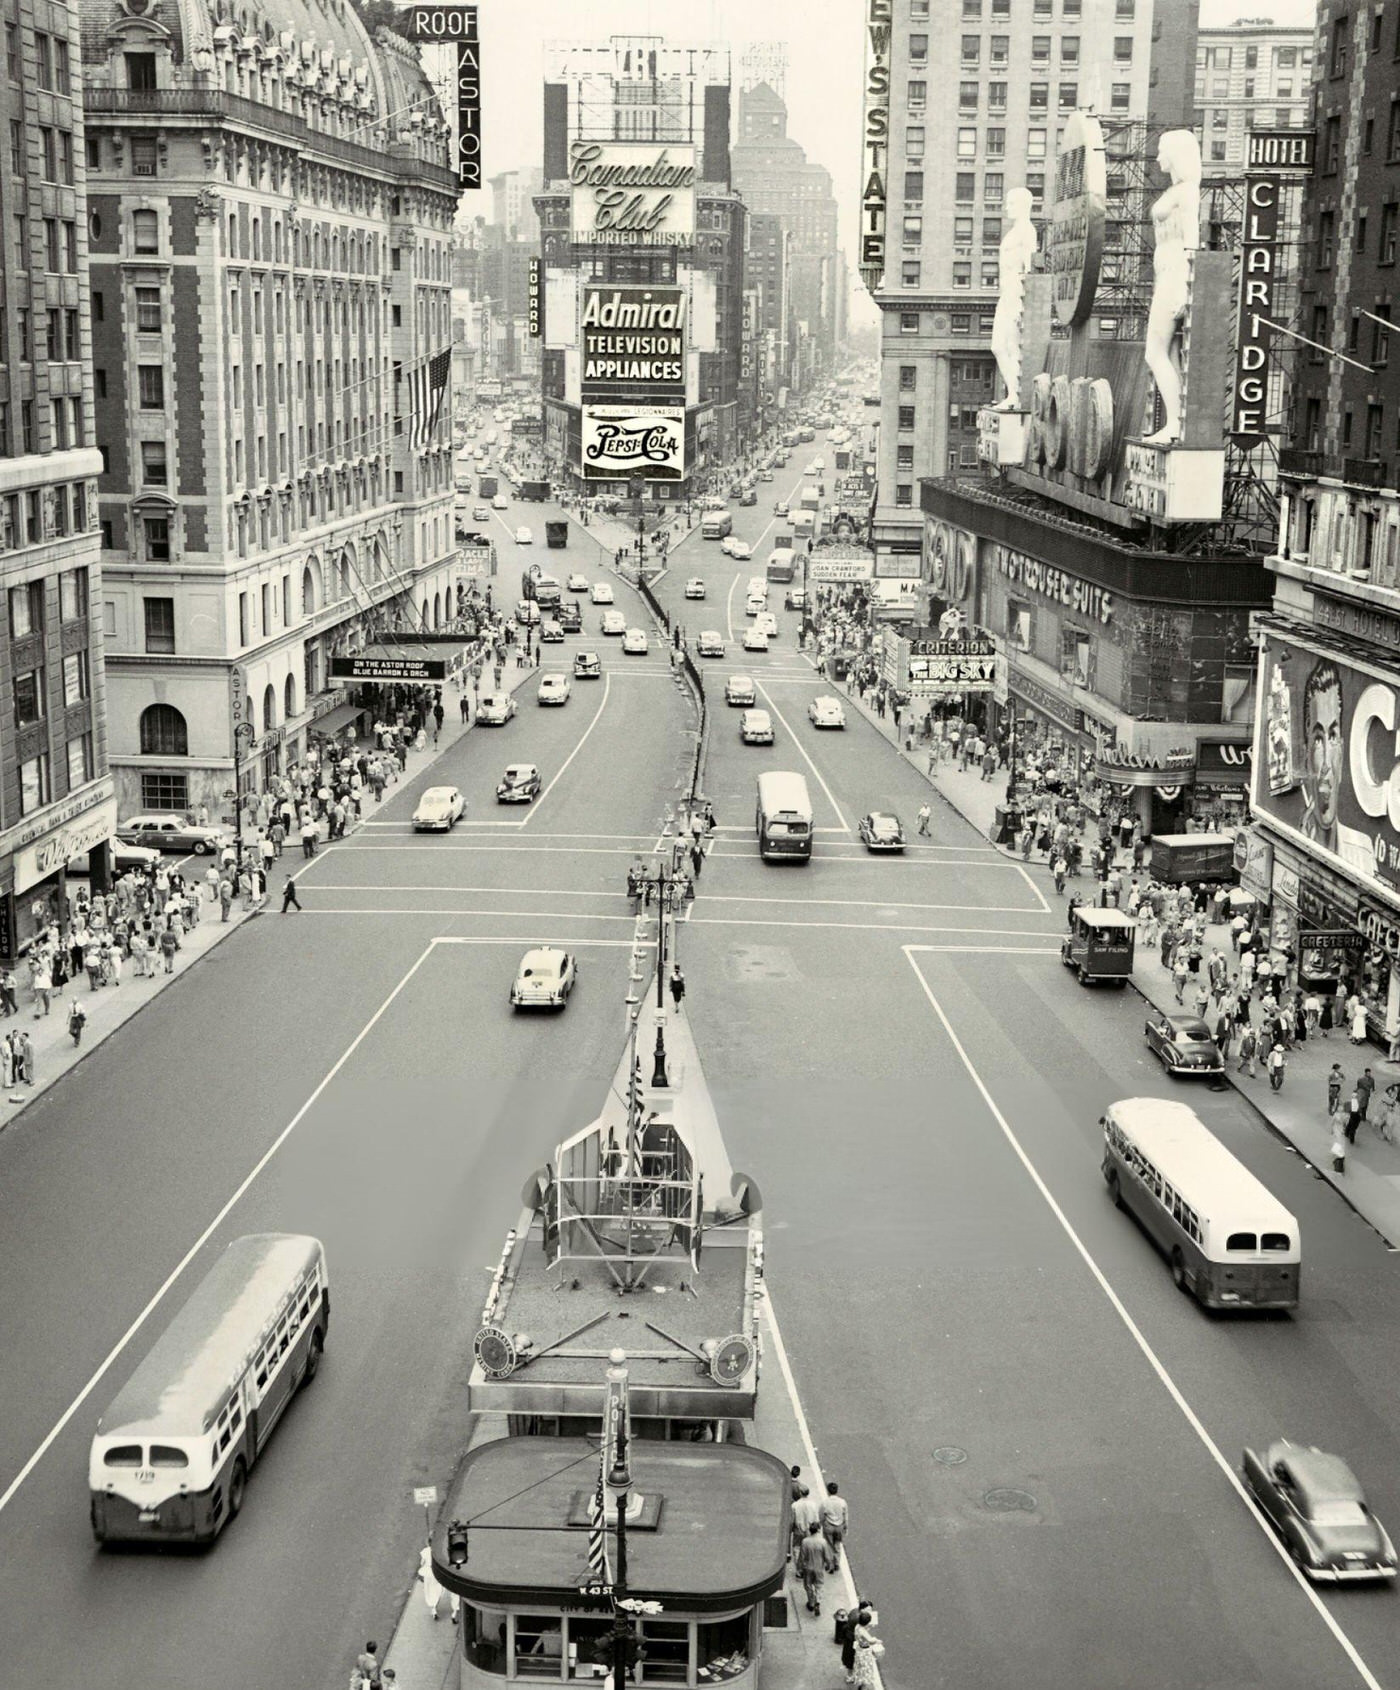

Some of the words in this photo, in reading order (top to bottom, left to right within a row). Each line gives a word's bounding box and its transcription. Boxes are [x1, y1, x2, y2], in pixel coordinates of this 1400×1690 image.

[416, 12, 476, 35] ROOF
[458, 48, 480, 183] ASTOR
[569, 142, 696, 188] Canadian
[1250, 138, 1308, 164] HOTEL
[863, 108, 888, 262] STATE
[594, 187, 673, 231] Club
[574, 232, 638, 244] IMPORTED
[642, 231, 692, 245] WHISKY
[529, 261, 538, 333] HOWARD
[582, 292, 687, 329] Admiral
[1238, 181, 1274, 433] CLARIDGE
[586, 335, 681, 354] TELEVISION
[741, 306, 751, 378] HOWARD
[585, 360, 682, 379] APPLIANCES
[1072, 579, 1113, 624] SUITS
[1353, 610, 1389, 641] HOTEL
[918, 640, 989, 654] CRITERION
[373, 668, 401, 676] BARRON
[381, 661, 404, 669] ASTOR
[929, 662, 958, 679] BIG
[960, 662, 995, 679] SKY
[232, 668, 242, 721] ASTOR
[610, 1395, 619, 1471] POLIC
[589, 1587, 600, 1595] 43
[603, 1586, 613, 1594] ST
